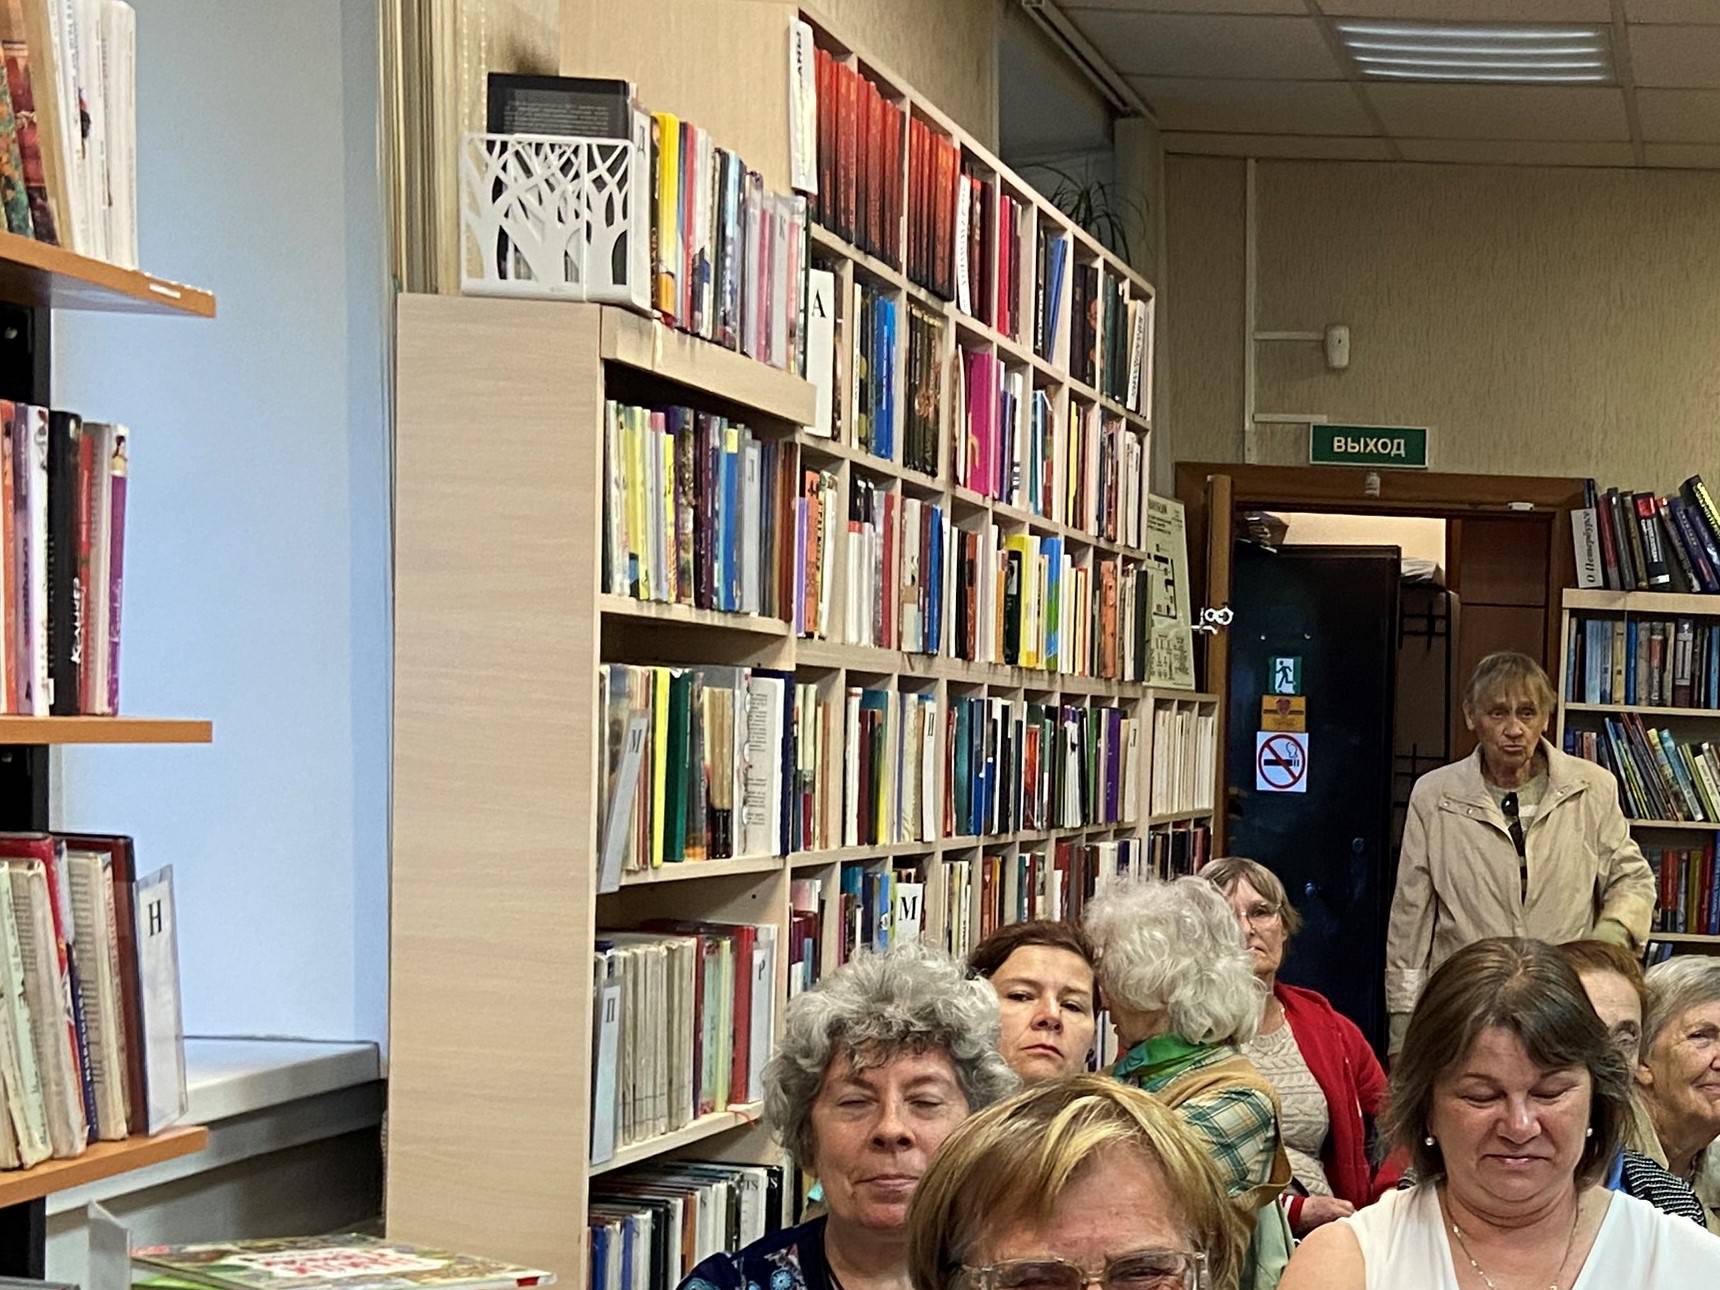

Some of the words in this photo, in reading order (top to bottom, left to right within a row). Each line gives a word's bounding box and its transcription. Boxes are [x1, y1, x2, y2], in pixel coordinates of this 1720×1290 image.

[811, 289, 827, 319] А
[1332, 435, 1406, 458] ВЫХОД
[148, 899, 163, 937] Н
[898, 895, 918, 921] М
[606, 997, 616, 1024] П
